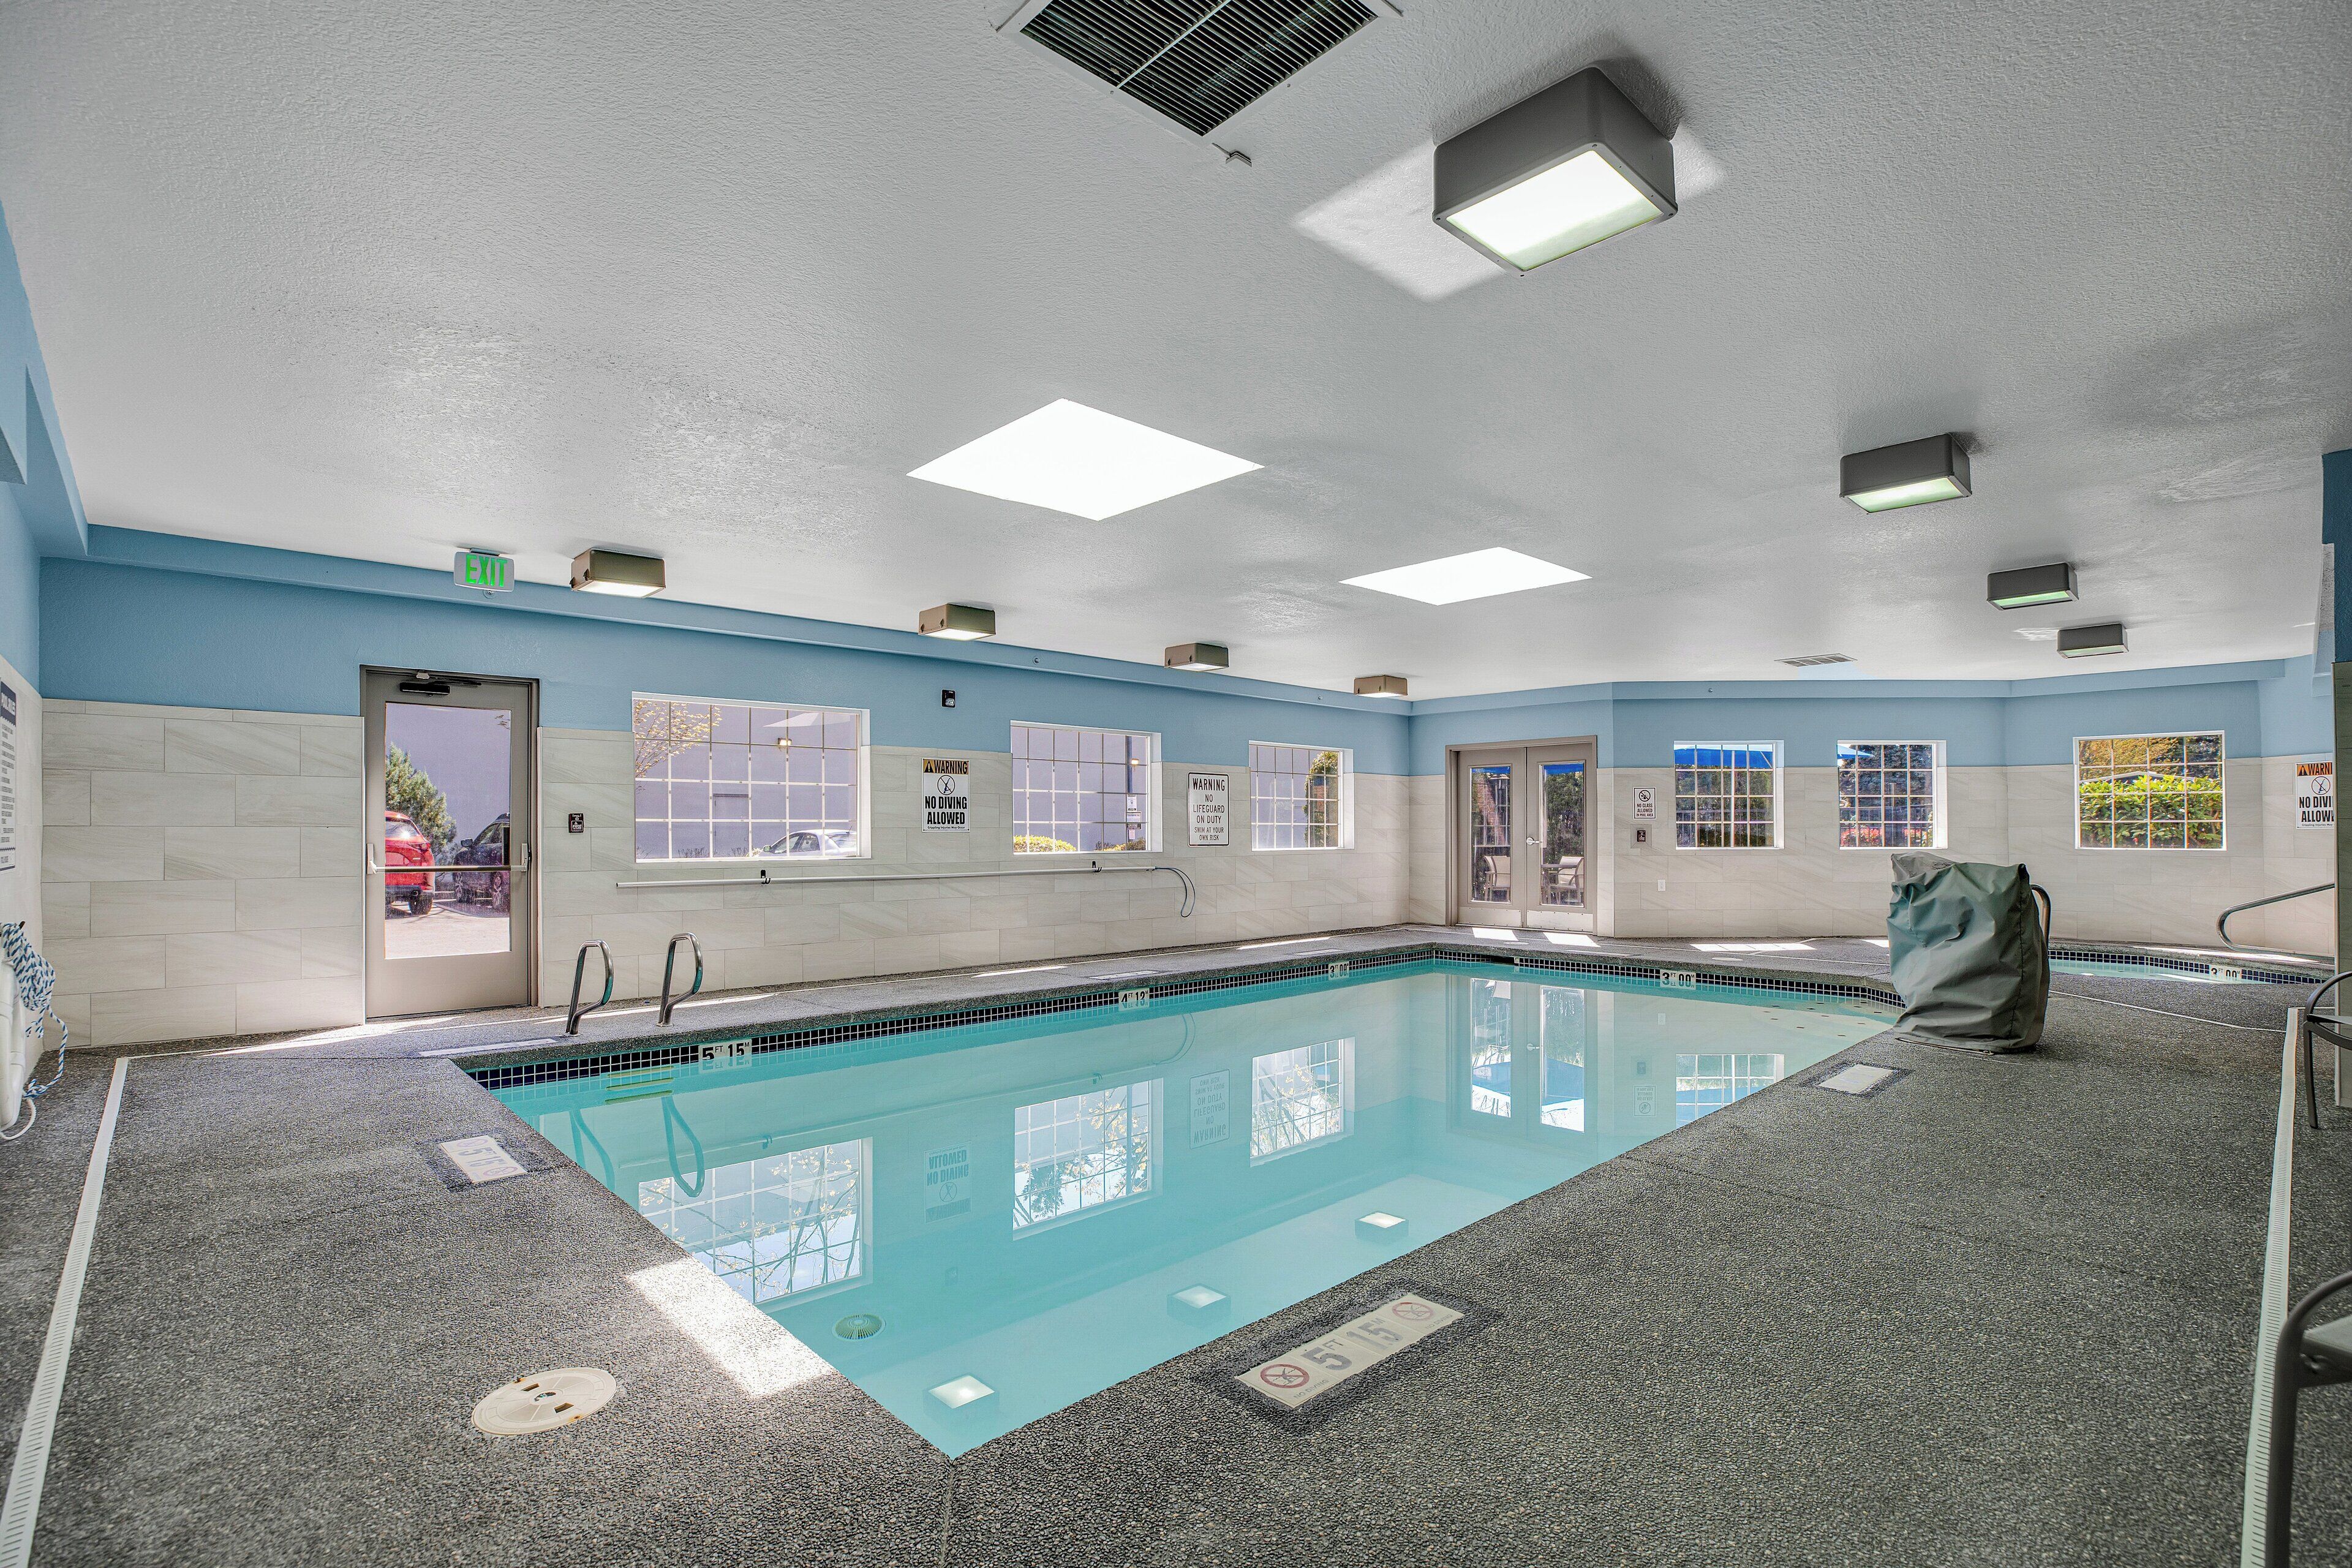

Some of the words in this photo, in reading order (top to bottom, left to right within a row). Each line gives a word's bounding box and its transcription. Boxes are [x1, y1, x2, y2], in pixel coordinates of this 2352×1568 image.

[466, 554, 508, 587] EXIT
[934, 760, 968, 774] WARNING
[2308, 762, 2332, 775] WARNI
[1193, 778, 1225, 791] WARNING
[925, 796, 937, 809] NO
[938, 796, 967, 809] DIVING
[1193, 804, 1225, 813] LIFEGUARD
[2299, 796, 2311, 809] NO
[2313, 796, 2332, 809] DIVI
[927, 812, 965, 824] ALLOWED
[1207, 815, 1222, 824] DUTY
[2301, 810, 2334, 823] ALLOW
[703, 1046, 715, 1061] 5
[1370, 1317, 1386, 1325] M
[1434, 1314, 1453, 1325] DIVING
[1322, 1339, 1344, 1351] FT
[1301, 1346, 1352, 1371] 5
[1293, 1391, 1306, 1400] NO
[1305, 1379, 1330, 1393] DIVING
